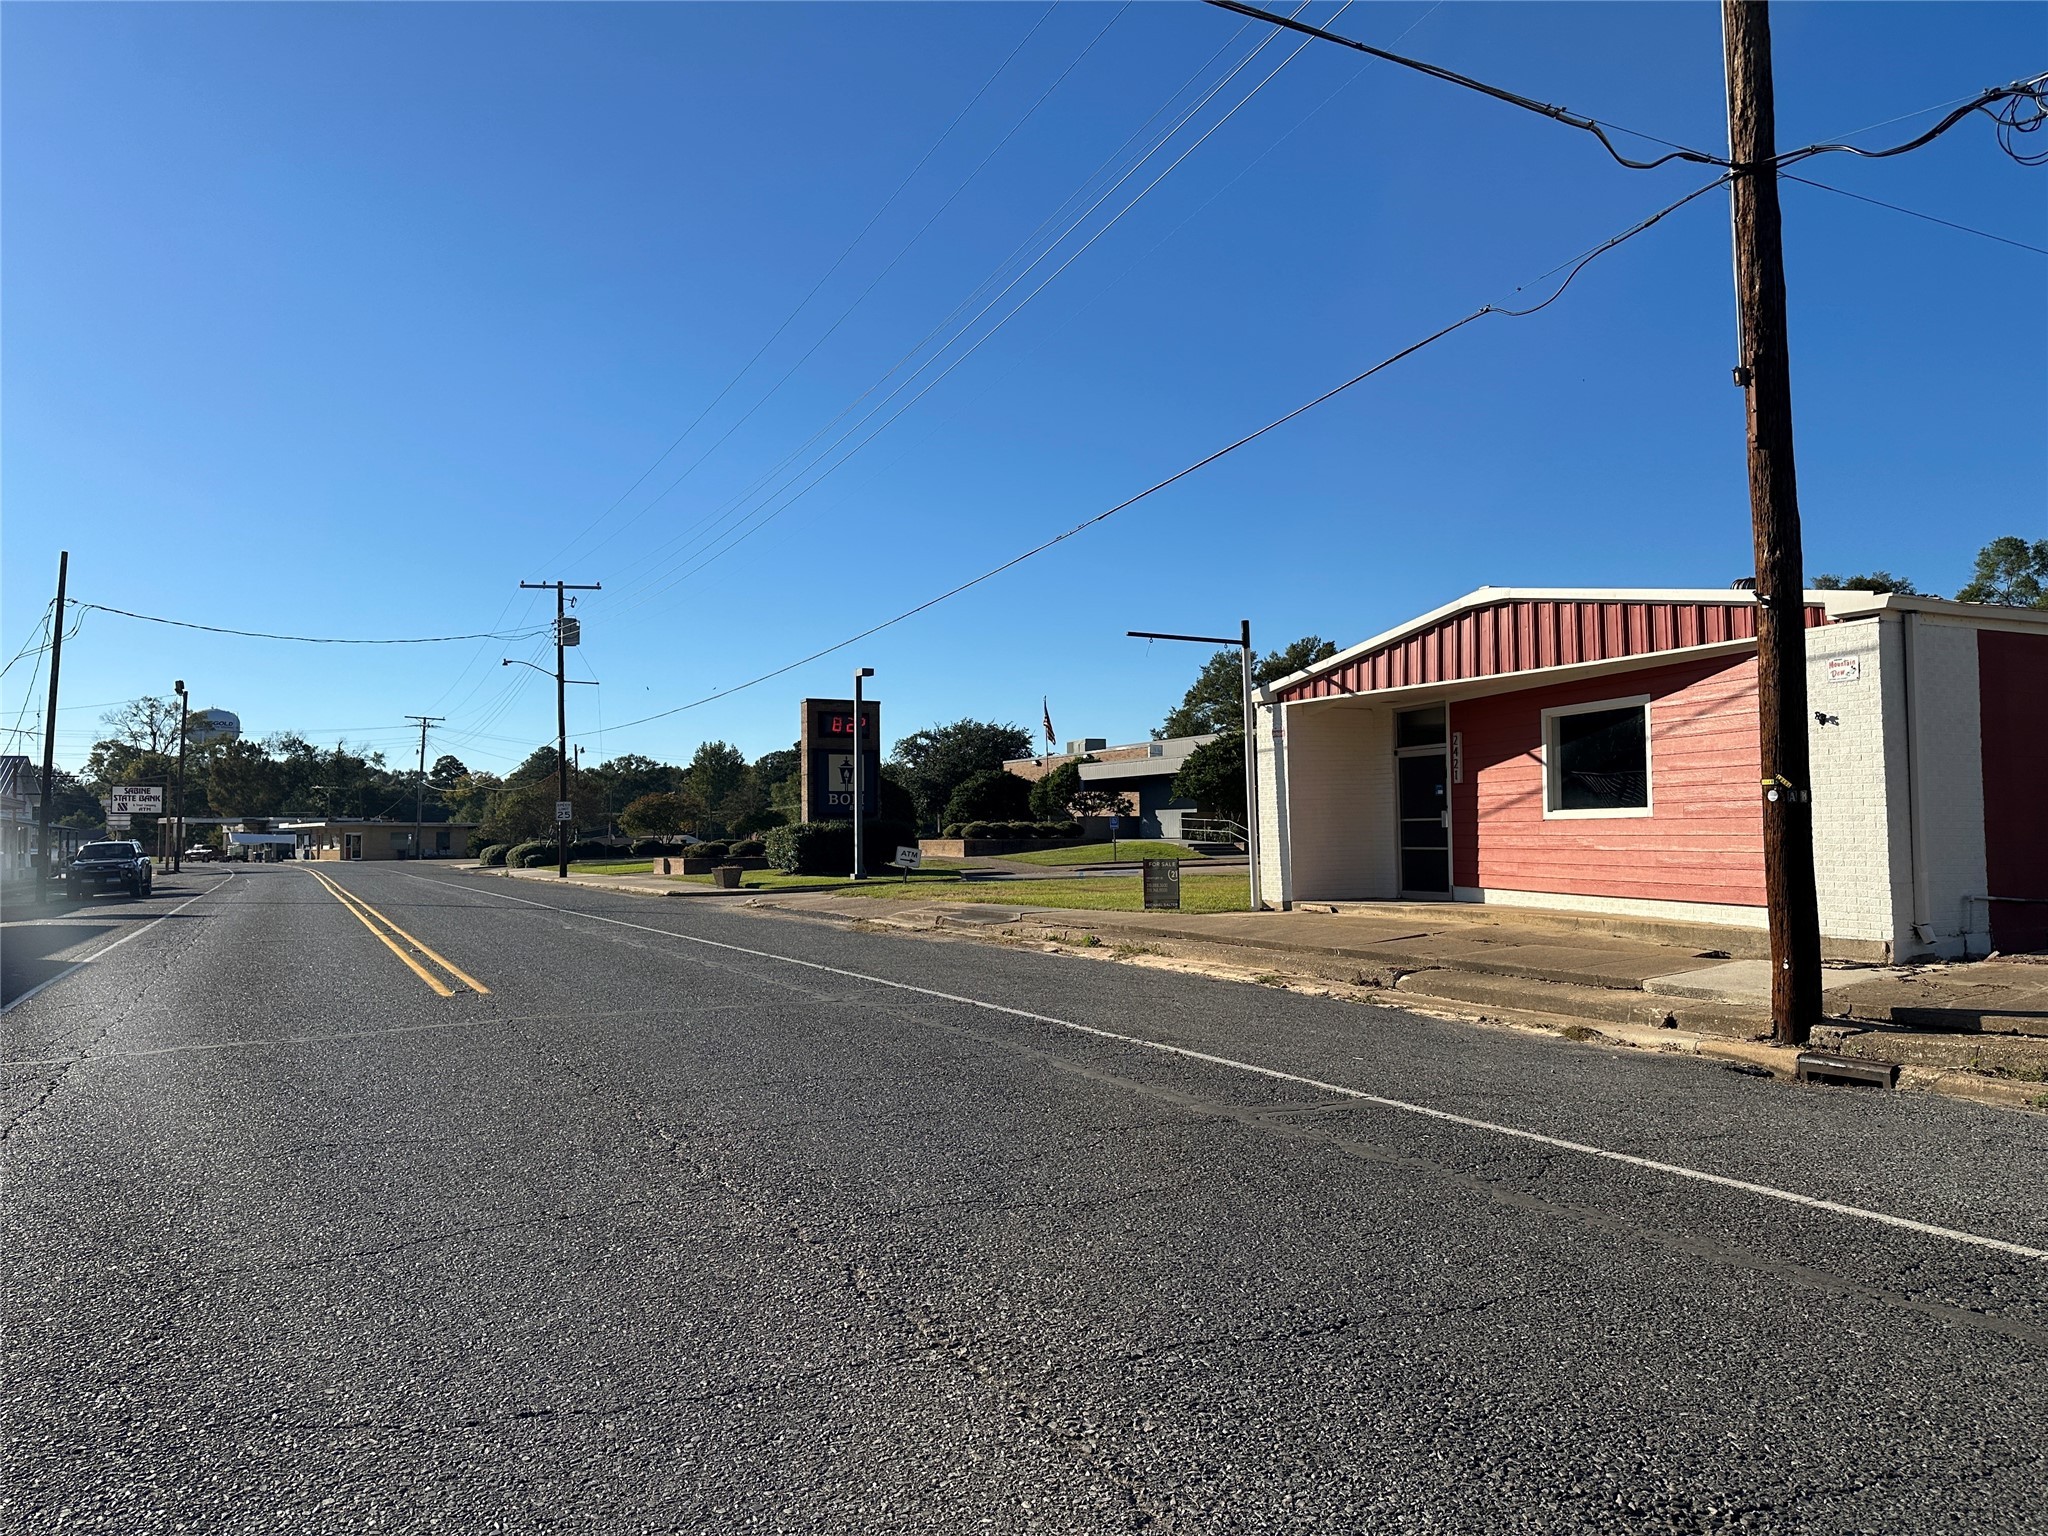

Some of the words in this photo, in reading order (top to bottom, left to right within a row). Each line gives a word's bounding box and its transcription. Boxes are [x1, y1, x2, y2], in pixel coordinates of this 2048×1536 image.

[1829, 660, 1856, 669] Mountain
[1831, 670, 1845, 678] Dew
[124, 787, 151, 795] SABINE
[113, 794, 137, 802] STATE
[138, 794, 161, 802] BANK
[557, 811, 571, 819] 25
[900, 850, 918, 858] ATM
